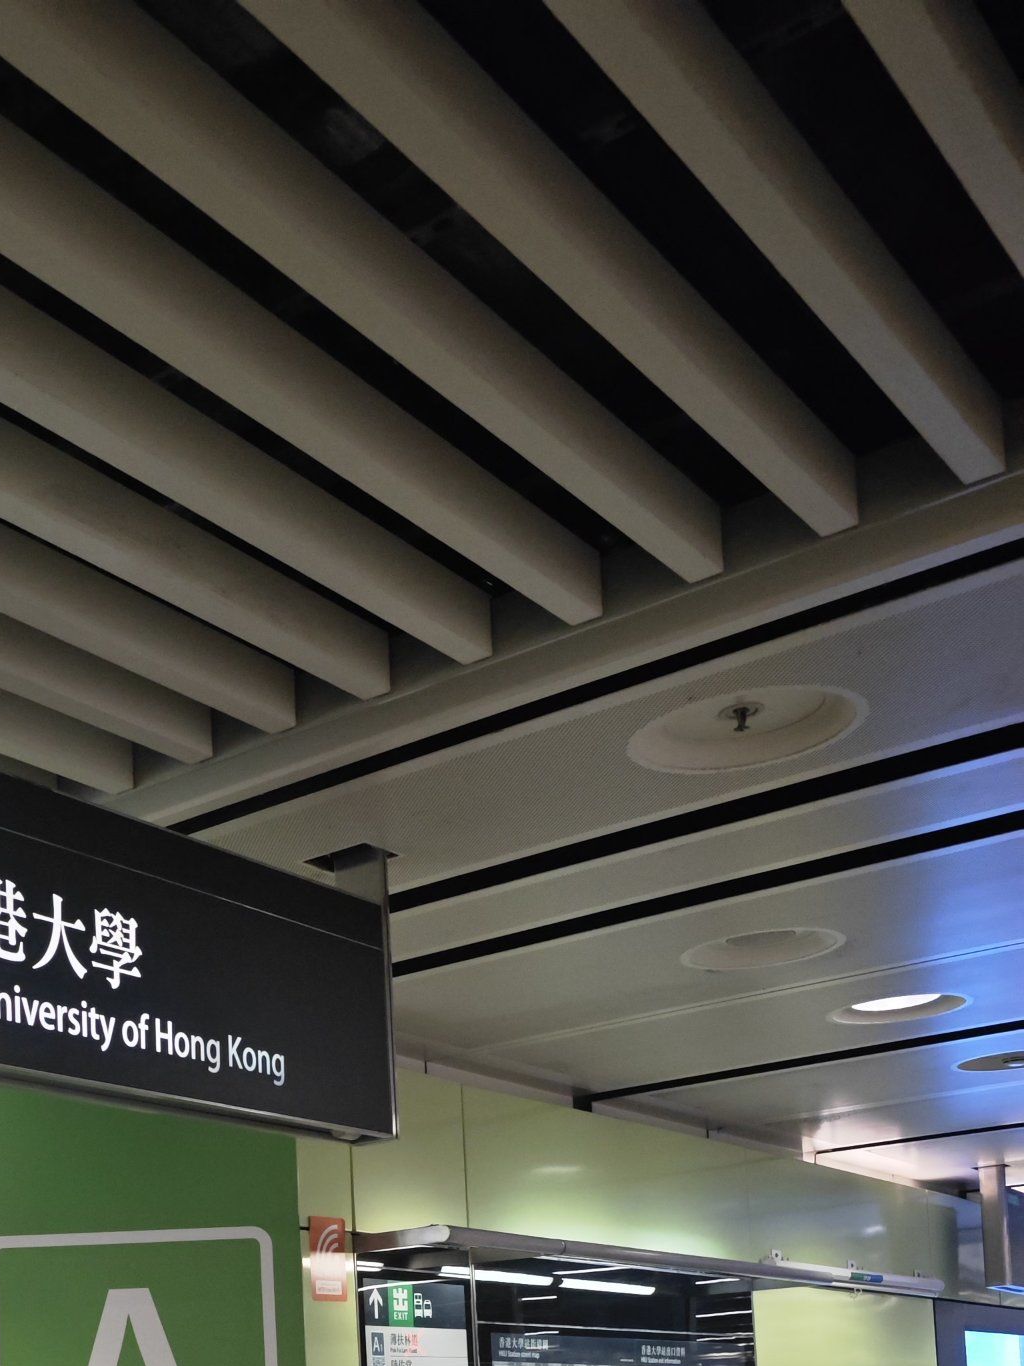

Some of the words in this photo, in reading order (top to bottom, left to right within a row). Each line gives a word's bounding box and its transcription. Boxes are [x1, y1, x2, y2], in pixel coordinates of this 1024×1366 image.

[121, 1012, 150, 1050] of
[154, 1017, 221, 1074] Hong
[227, 1034, 286, 1087] Kong
[393, 1311, 409, 1321] EXIT
